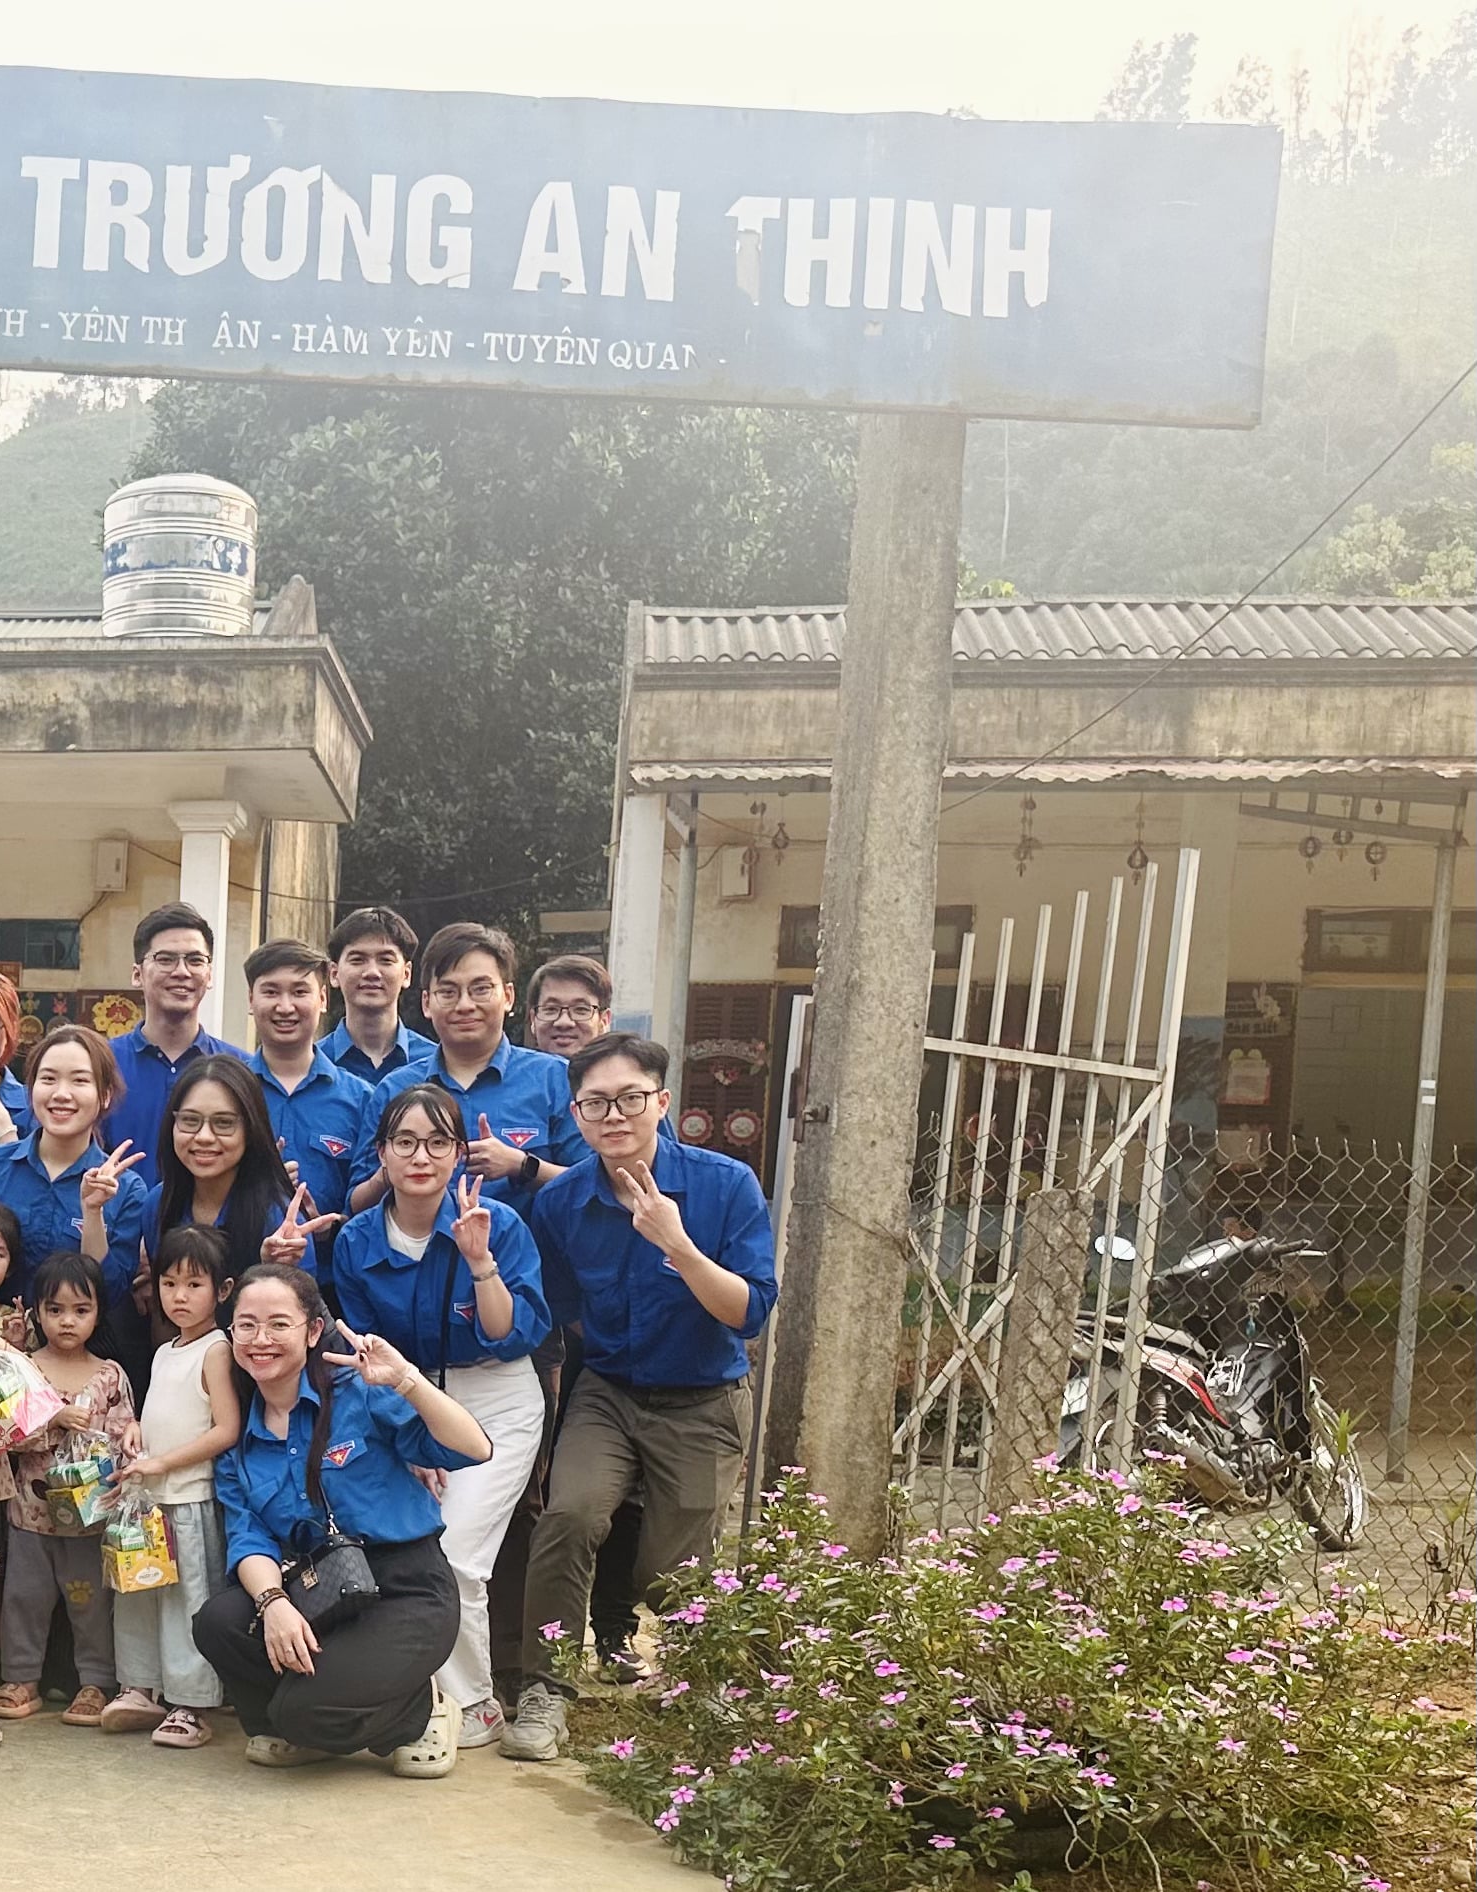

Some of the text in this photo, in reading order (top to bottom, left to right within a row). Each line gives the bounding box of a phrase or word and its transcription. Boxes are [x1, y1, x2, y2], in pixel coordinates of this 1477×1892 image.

[512, 181, 681, 303] AN
[58, 305, 131, 343] YÊN
[141, 311, 263, 355] THẬN
[291, 314, 370, 355] HÀM
[380, 315, 453, 359] YÊN
[482, 325, 601, 366] TUYÊN
